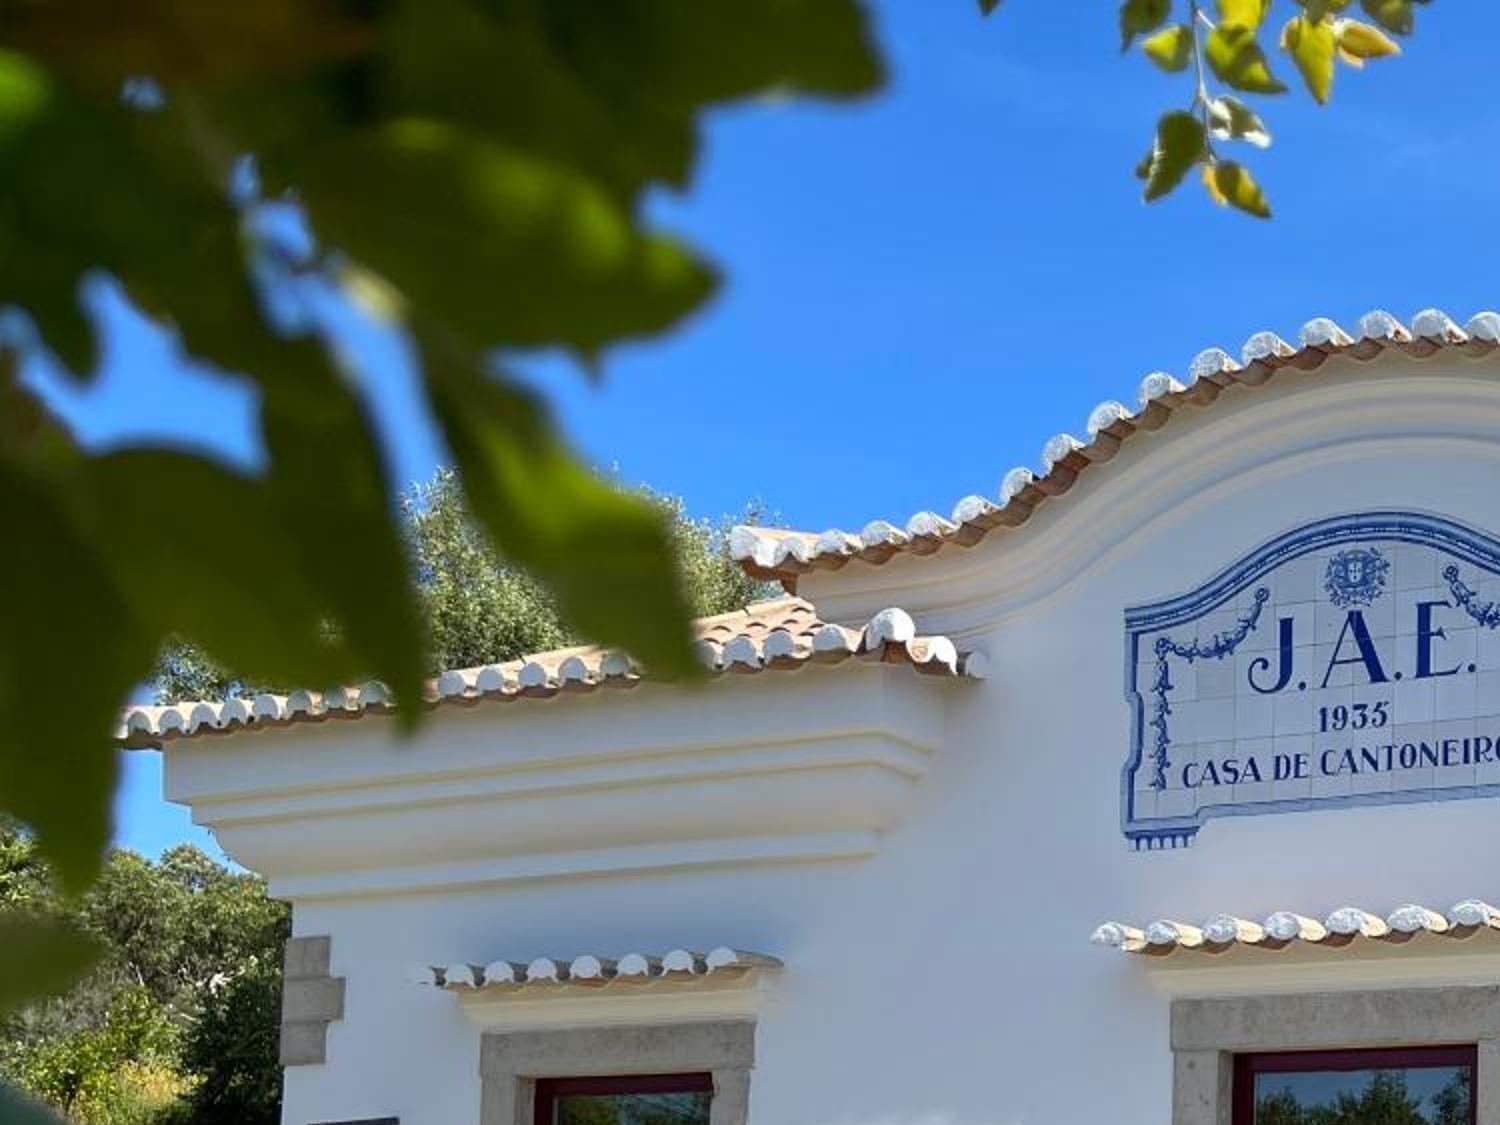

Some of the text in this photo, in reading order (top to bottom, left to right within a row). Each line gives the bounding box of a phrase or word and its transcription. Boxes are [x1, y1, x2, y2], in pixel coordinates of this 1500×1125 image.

[1247, 600, 1477, 695] J.A.E.
[1318, 700, 1389, 733] 1935
[1181, 757, 1262, 789] CASA
[1273, 752, 1309, 781] DE
